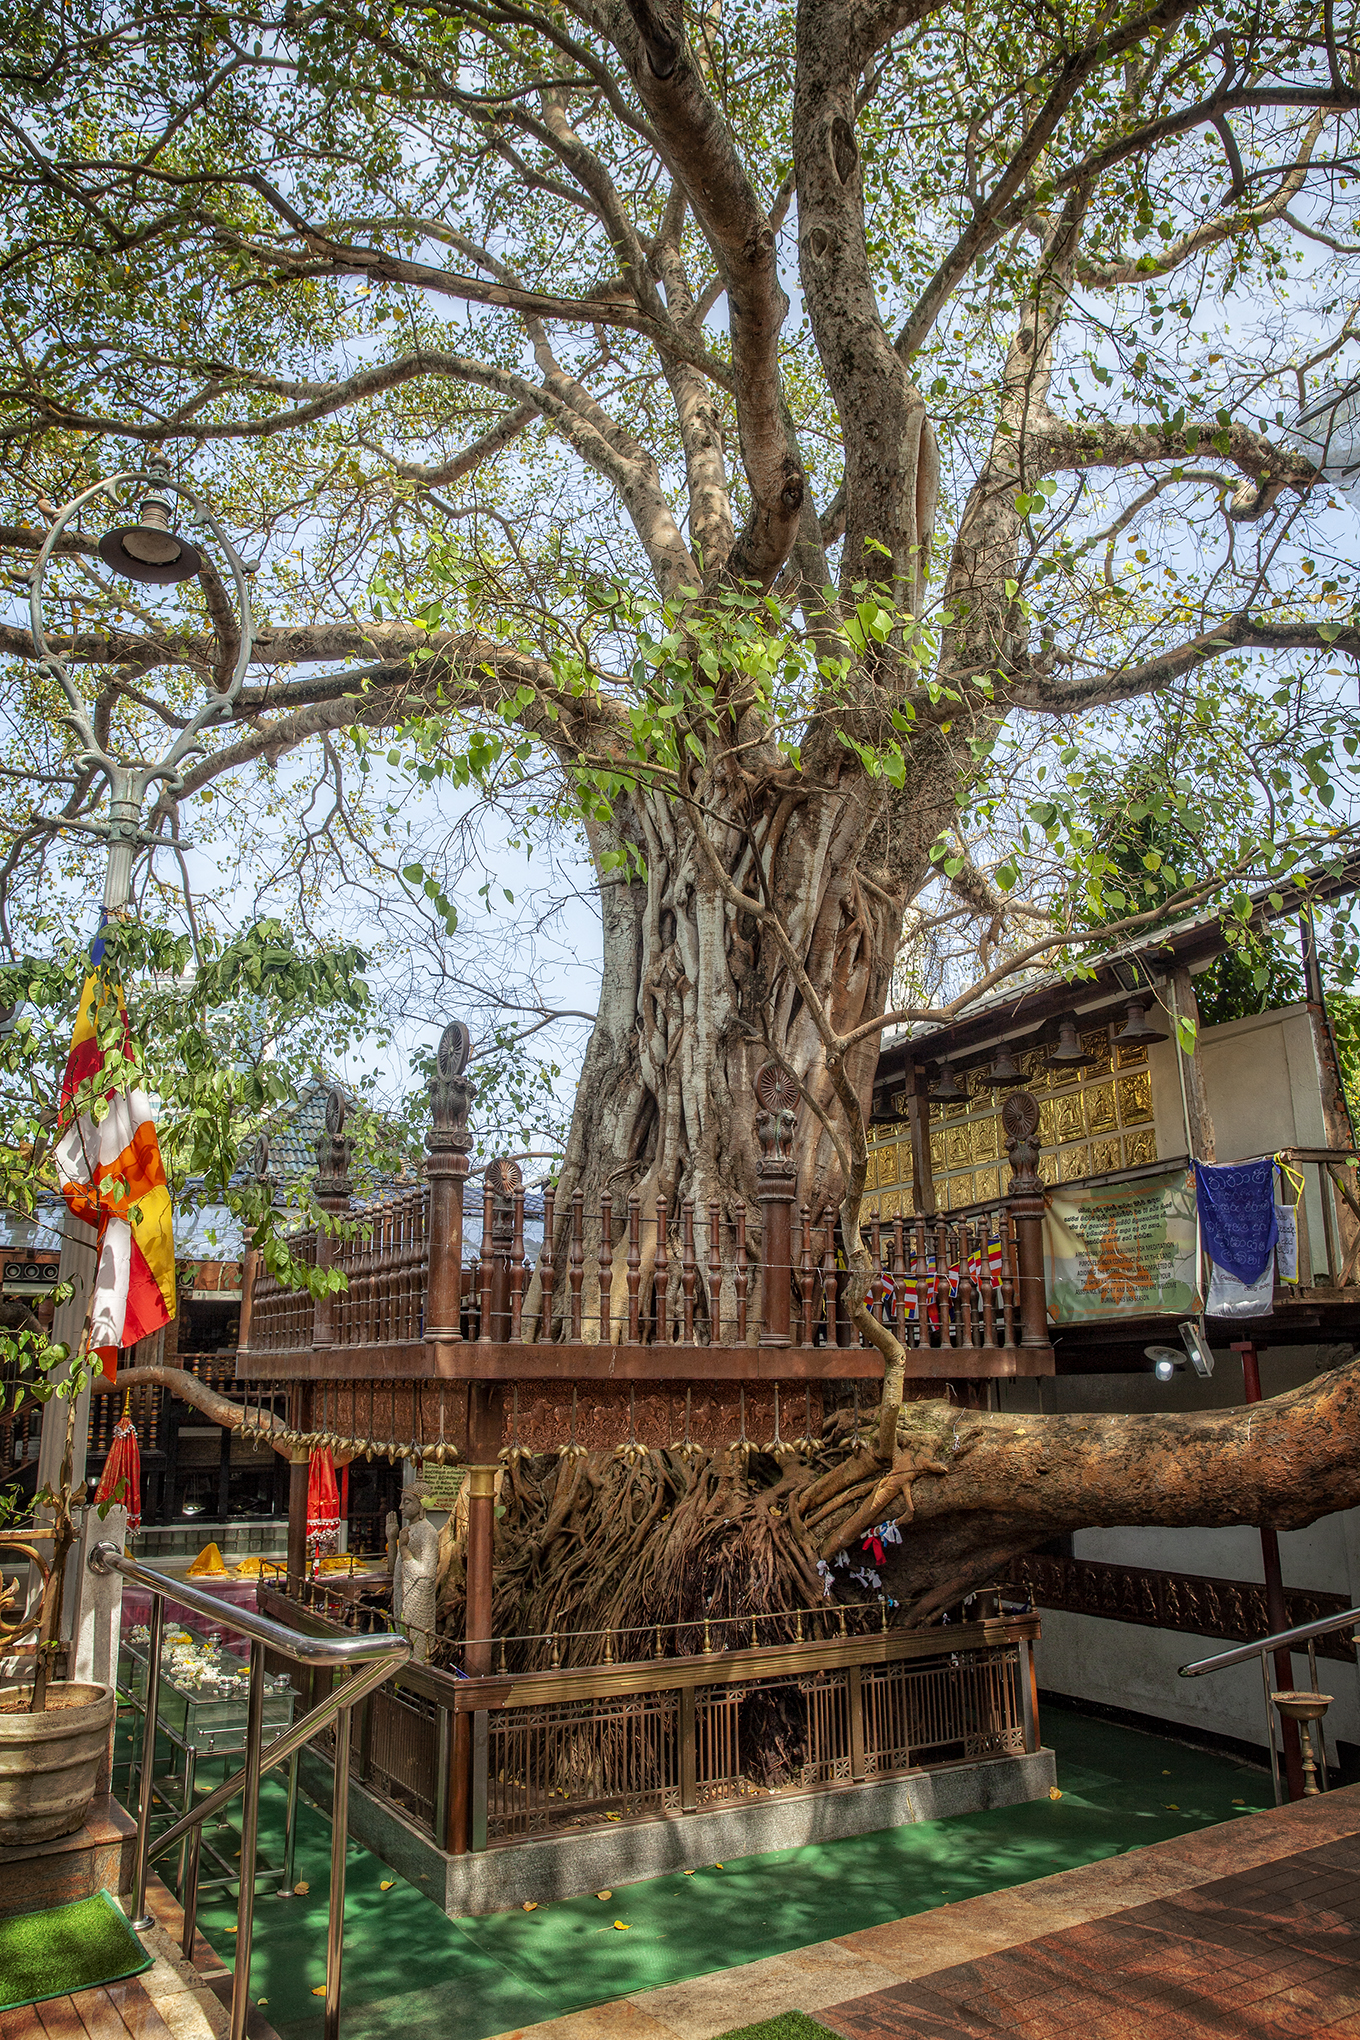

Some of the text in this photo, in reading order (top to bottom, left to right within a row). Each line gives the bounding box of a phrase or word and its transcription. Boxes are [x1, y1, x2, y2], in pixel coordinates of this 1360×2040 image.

[1146, 1242, 1174, 1250] MEDITATION
[1142, 1263, 1168, 1271] COMPLETED
[1157, 1281, 1177, 1290] WELCOME
